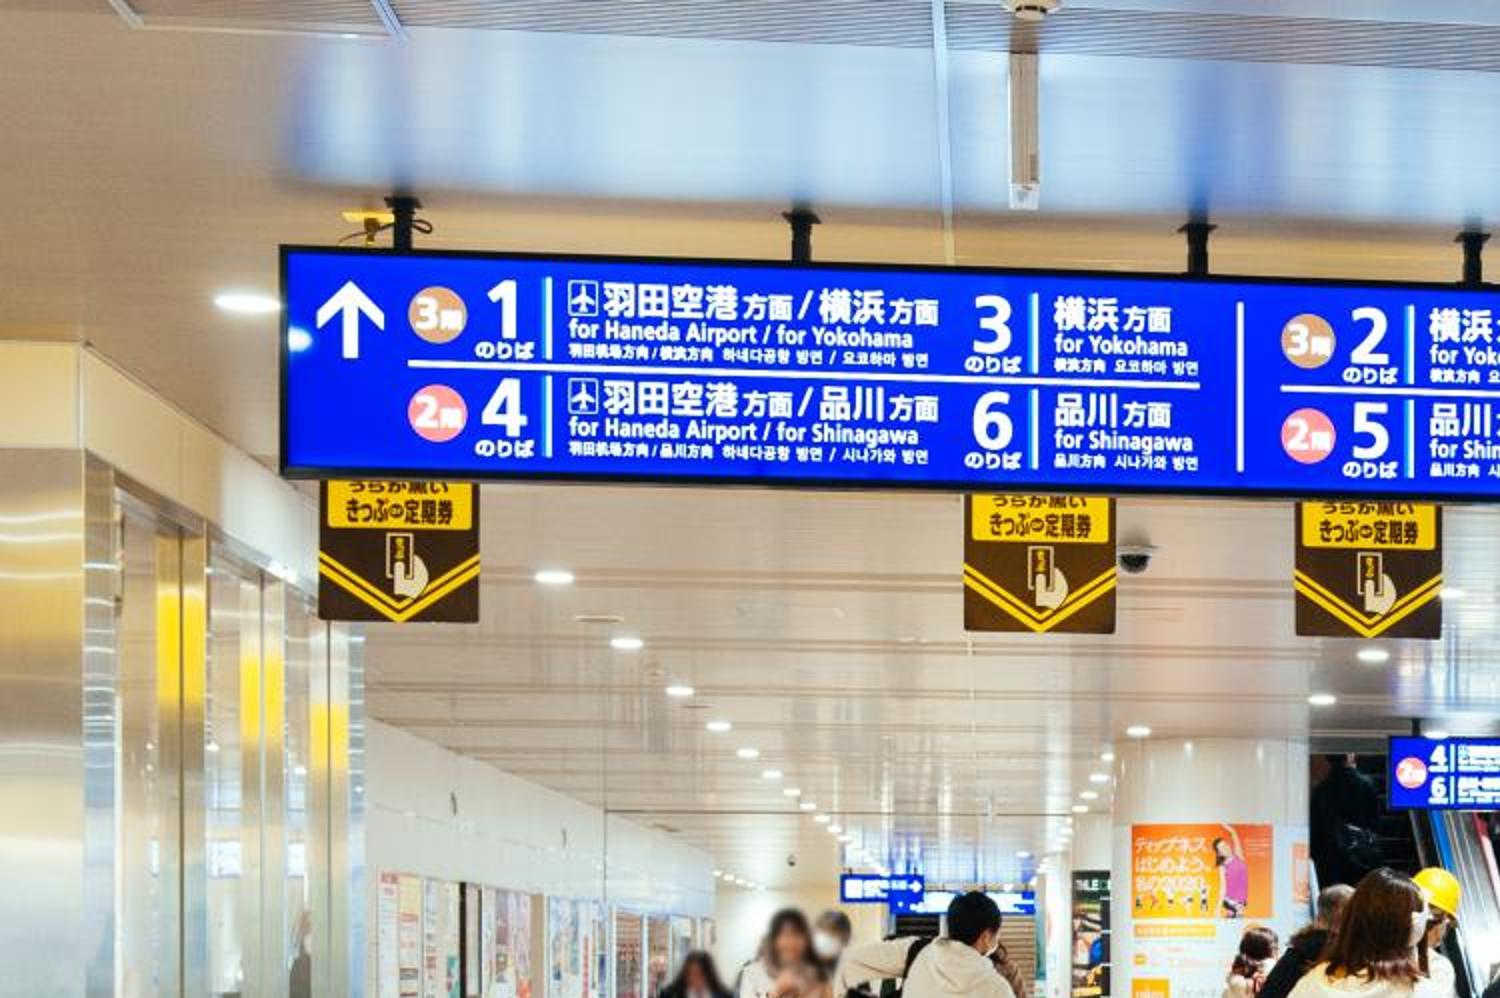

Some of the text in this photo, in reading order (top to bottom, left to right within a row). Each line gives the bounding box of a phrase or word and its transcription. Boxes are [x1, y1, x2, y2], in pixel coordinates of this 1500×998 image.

[487, 279, 517, 339] 1
[569, 317, 913, 349] for Haneda Airport / for Yokohama
[972, 294, 1012, 354] 3
[1350, 306, 1390, 365] 2
[474, 341, 535, 360] のりば
[1054, 335, 1188, 357] for Yokohama
[1429, 346, 1459, 365] for
[964, 356, 1022, 374] のりば
[1342, 367, 1399, 385] のりば
[481, 377, 528, 437] 4
[972, 390, 1013, 451] 6
[1351, 402, 1390, 460] 5
[569, 416, 919, 449] for Haneda Airport / for Shinagawa
[1054, 430, 1193, 455] for Shinagawa
[474, 439, 535, 458] のりば
[1429, 440, 1459, 460] for
[964, 452, 1022, 470] のりば
[1342, 461, 1399, 479] のりば
